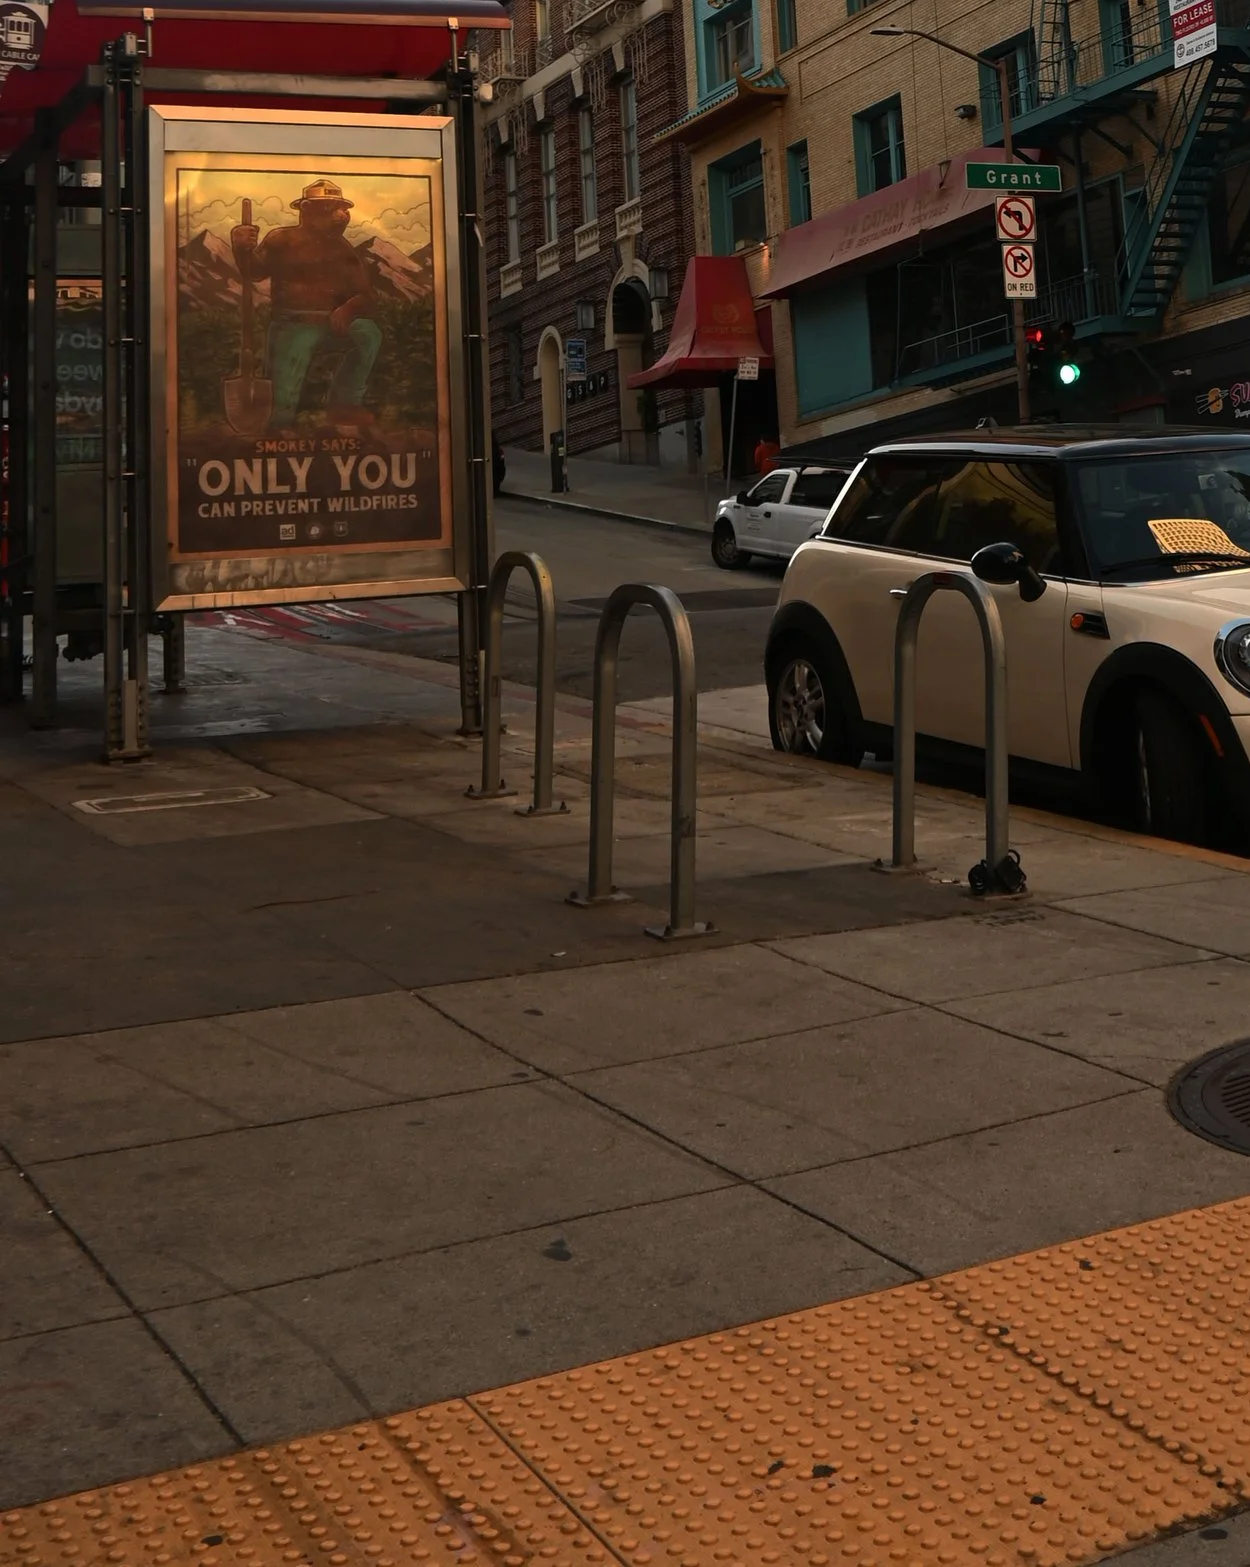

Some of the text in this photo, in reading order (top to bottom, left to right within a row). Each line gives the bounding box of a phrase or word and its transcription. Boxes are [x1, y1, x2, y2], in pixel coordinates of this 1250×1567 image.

[1173, 13, 1189, 28] FOR
[1189, 2, 1213, 21] LEASE
[1, 51, 26, 60] CABLE
[986, 169, 1042, 185] Grant
[1007, 283, 1034, 292] ON RED
[255, 438, 361, 453] SMOKEY SAYS:
[198, 494, 418, 518] CAN PREVENT WILDFIRES
